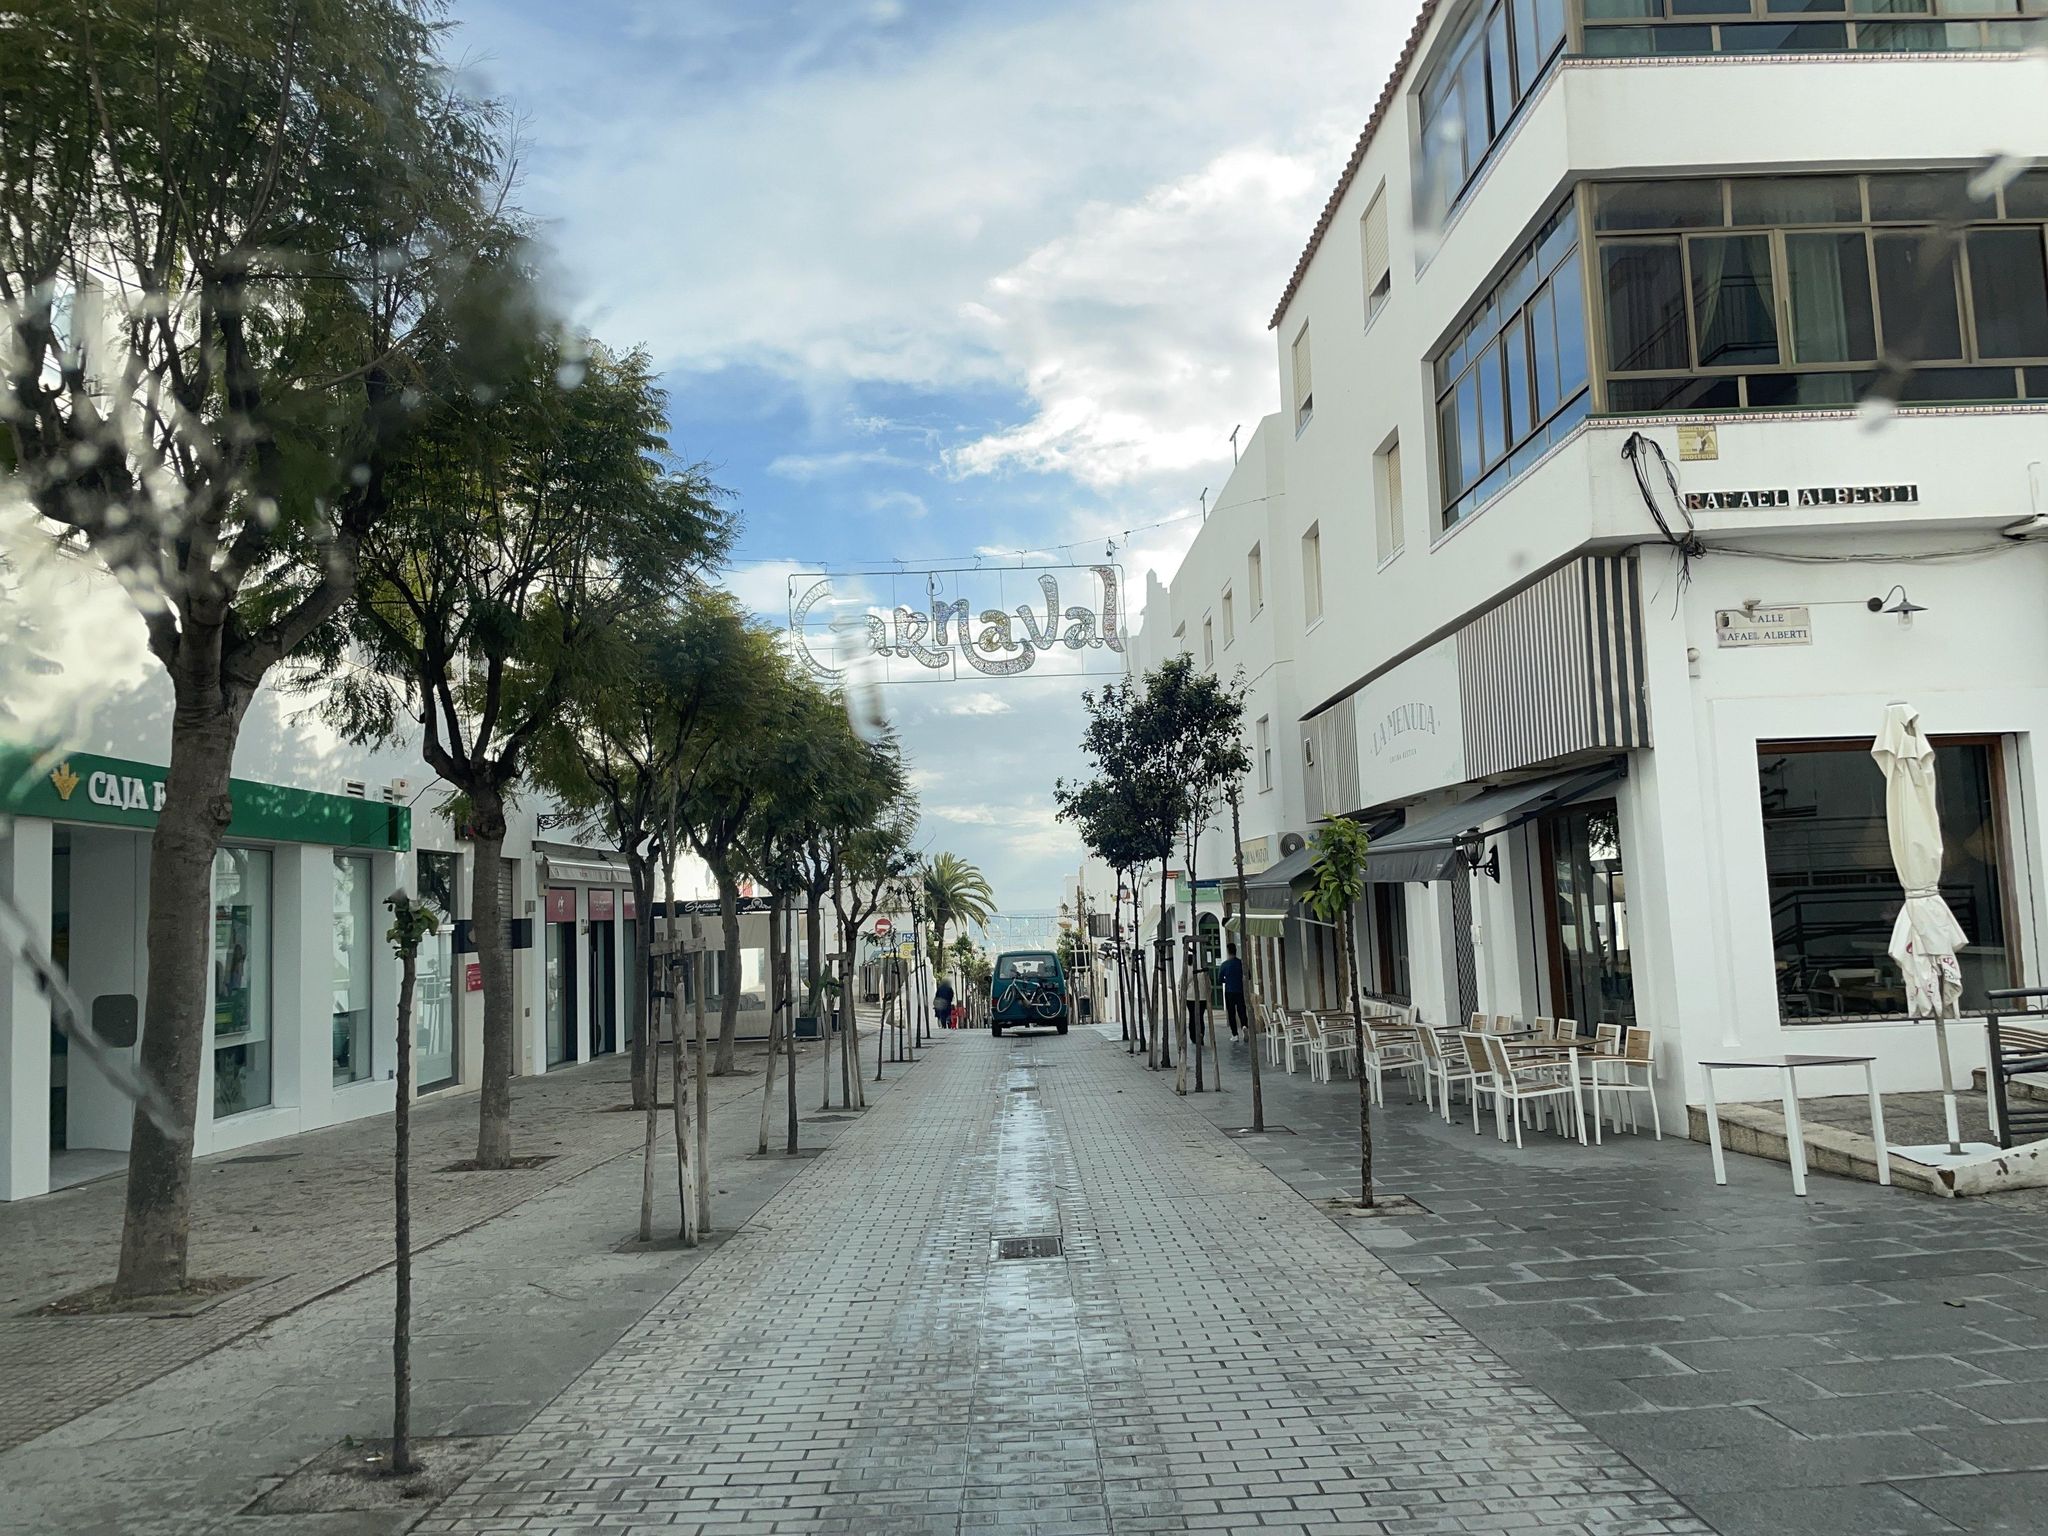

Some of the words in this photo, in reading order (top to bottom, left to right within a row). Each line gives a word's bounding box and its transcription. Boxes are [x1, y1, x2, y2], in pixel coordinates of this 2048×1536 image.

[1687, 491, 1788, 509] RAFAEL
[1799, 486, 1916, 507] ALBERTI
[1750, 613, 1784, 623] CALLE
[1719, 631, 1760, 641] AFAEL
[1764, 630, 1807, 640] ALBERTI
[1373, 722, 1387, 757] LA
[1387, 702, 1436, 742] MENUDA
[88, 771, 149, 810] CAJA
